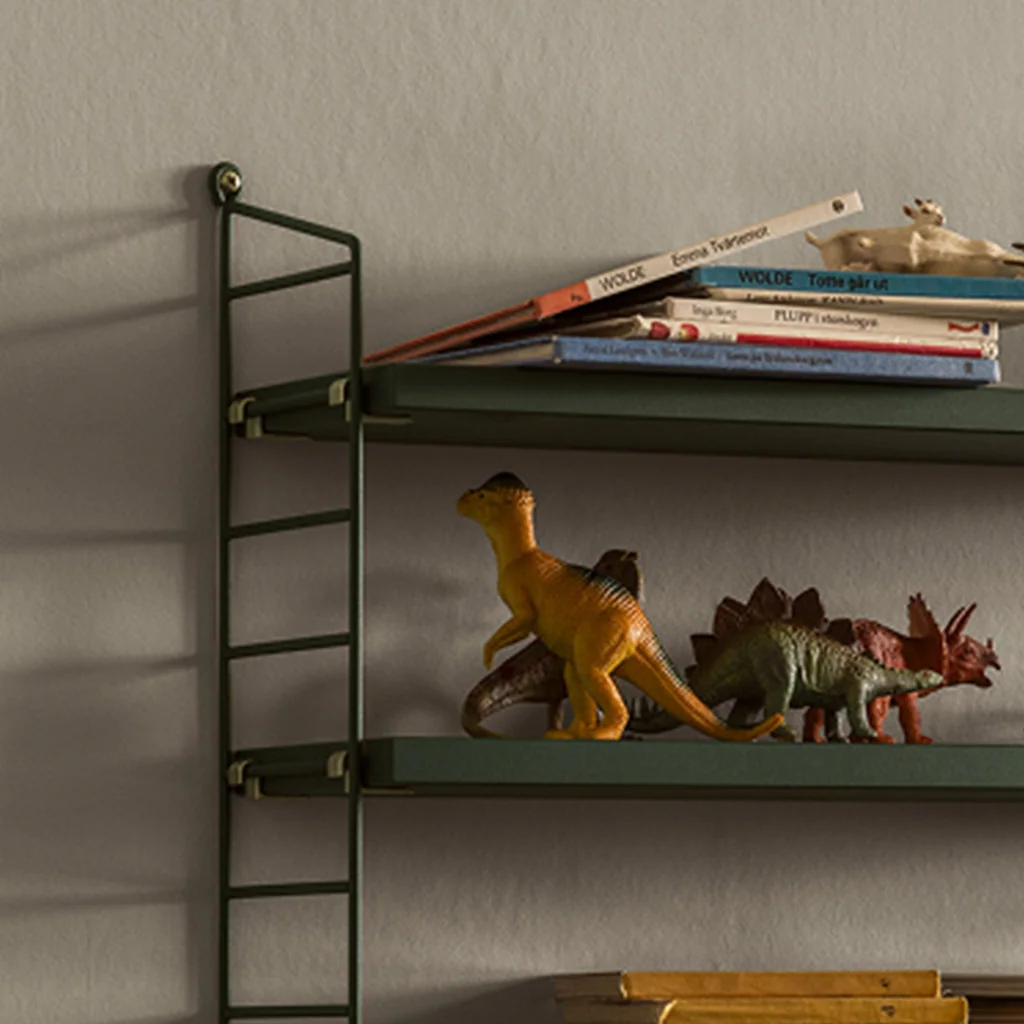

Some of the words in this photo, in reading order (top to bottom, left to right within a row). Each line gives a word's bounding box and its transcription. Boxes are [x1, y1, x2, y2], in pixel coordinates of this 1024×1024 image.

[598, 266, 647, 292] WOLDE
[738, 269, 793, 287] WOLDE
[849, 276, 872, 292] går
[873, 279, 889, 291] ut
